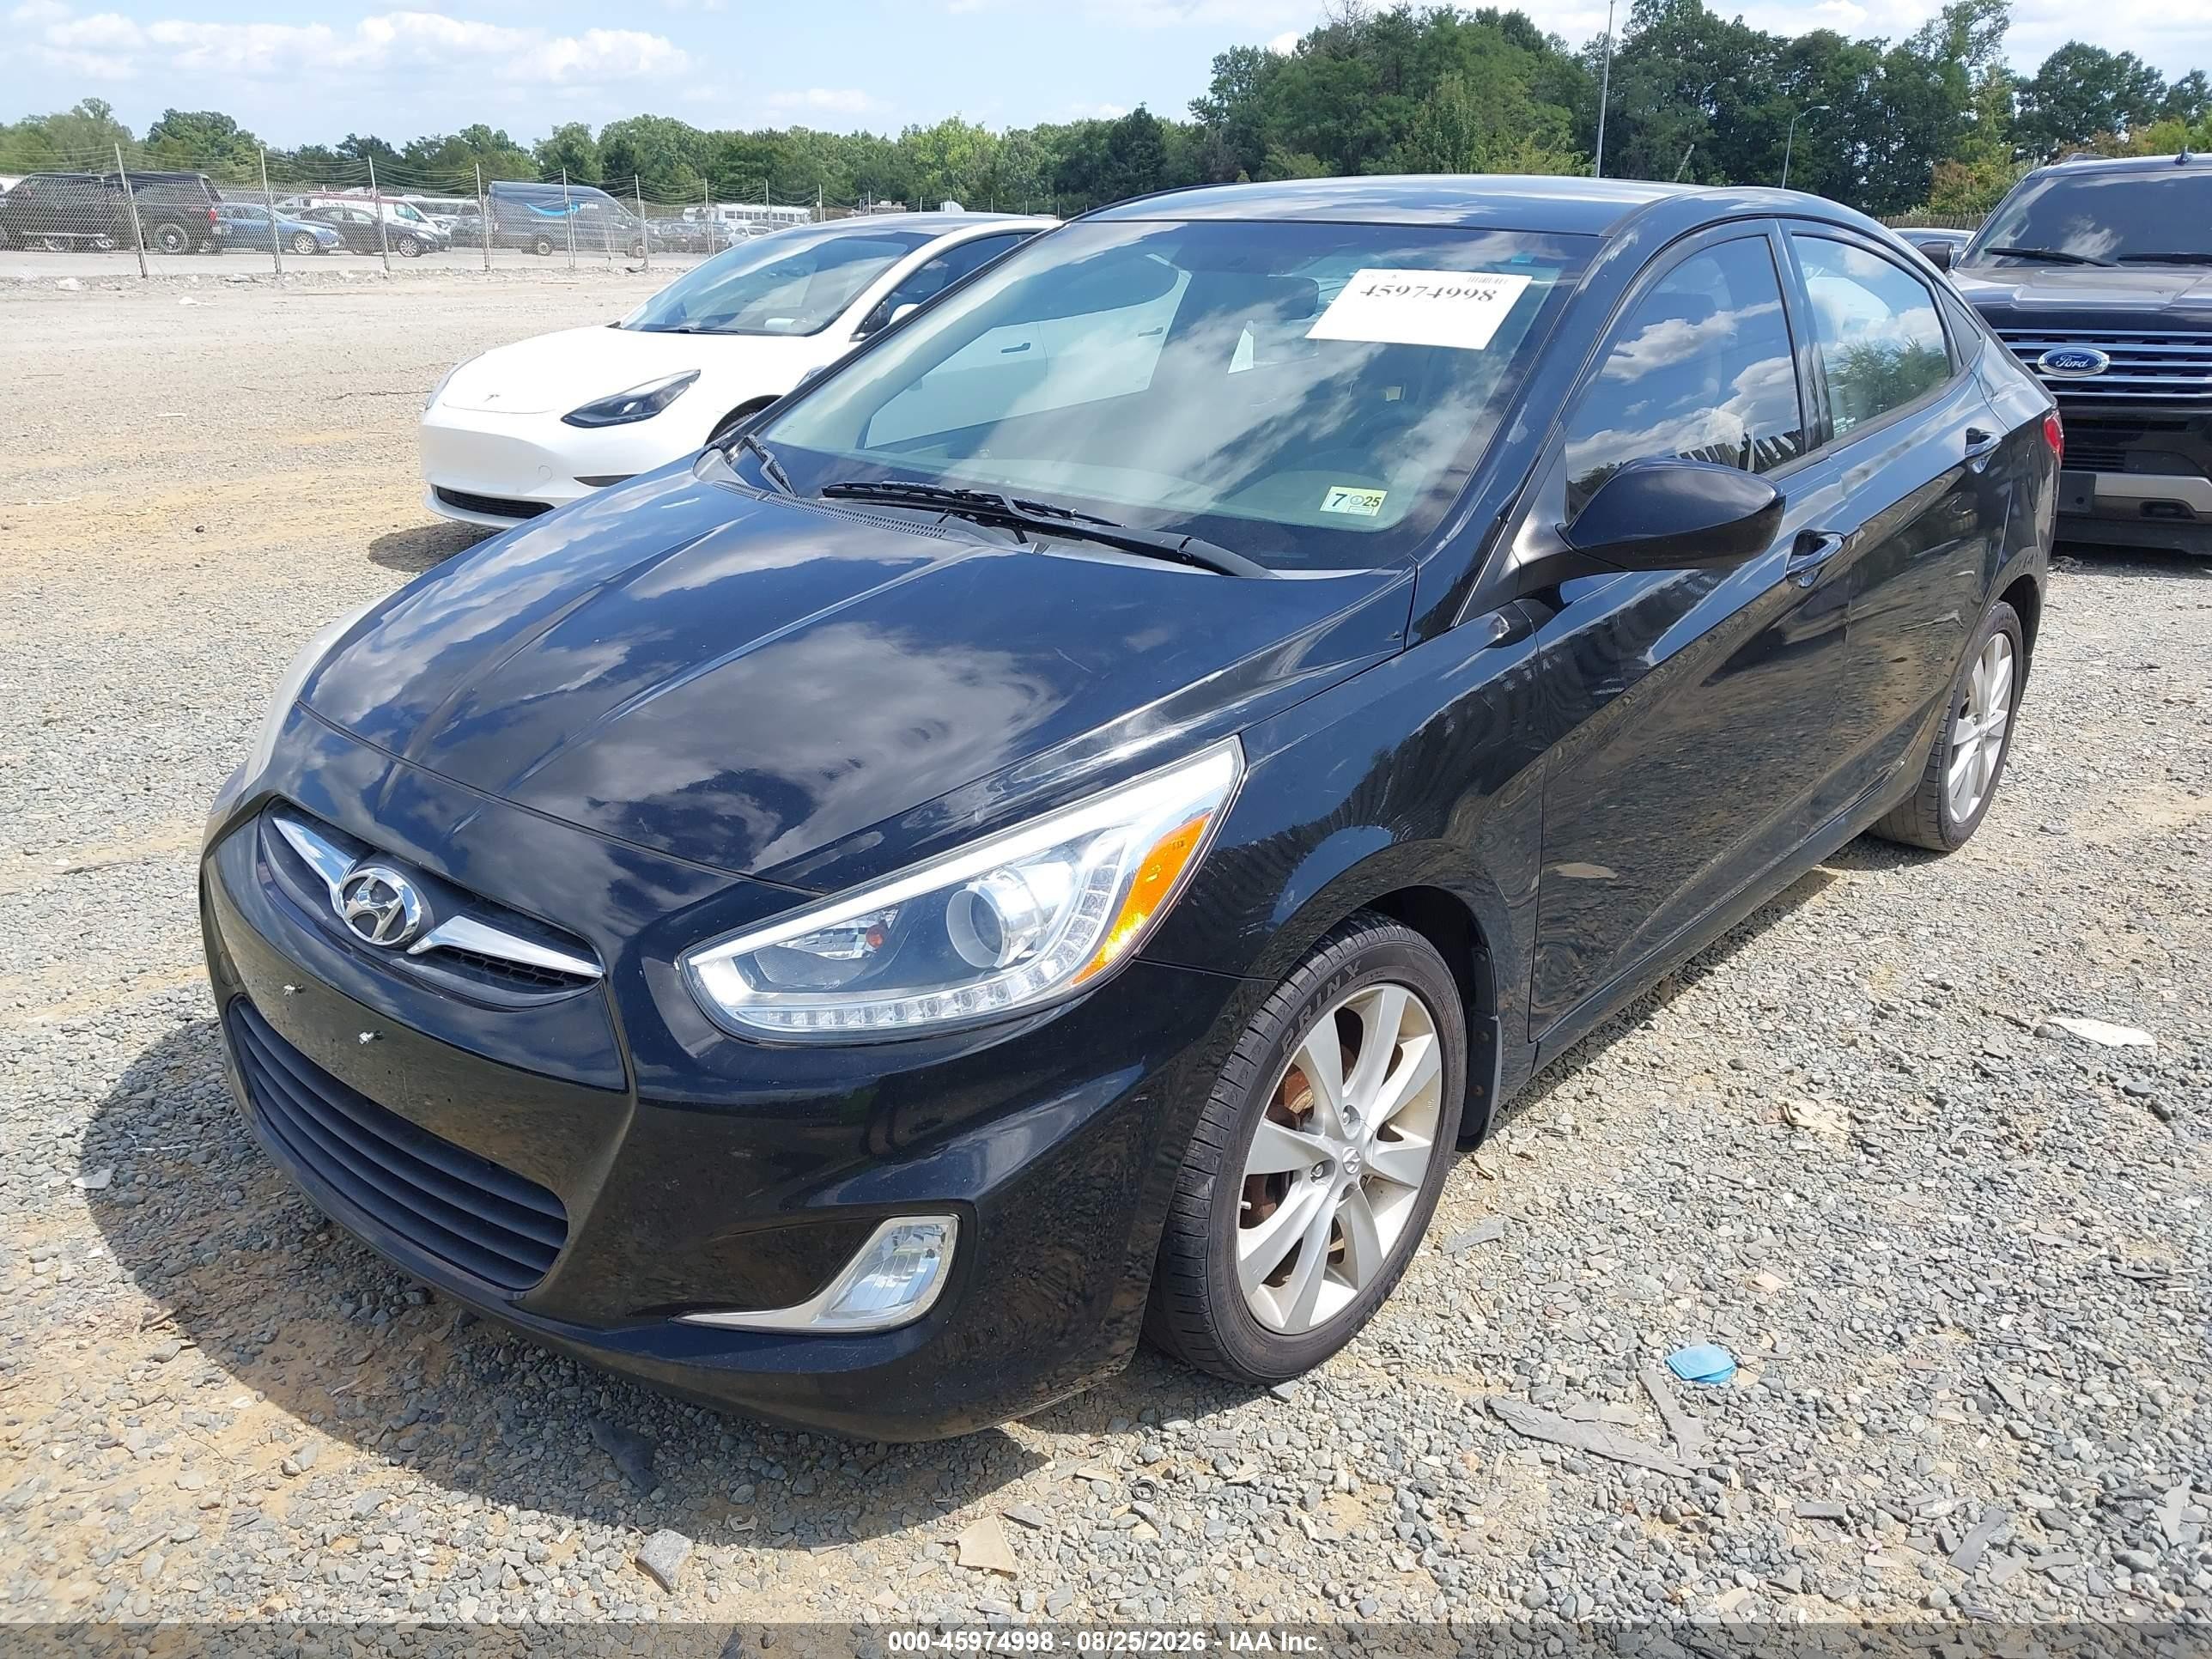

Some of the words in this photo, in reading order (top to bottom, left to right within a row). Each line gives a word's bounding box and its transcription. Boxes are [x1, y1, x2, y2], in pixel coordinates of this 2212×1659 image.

[1360, 284, 1498, 301] 45974998
[2056, 355, 2089, 368] Ford
[1333, 494, 1347, 507] 7
[1362, 495, 1382, 507] 25
[1281, 960, 1361, 1053] PRINX
